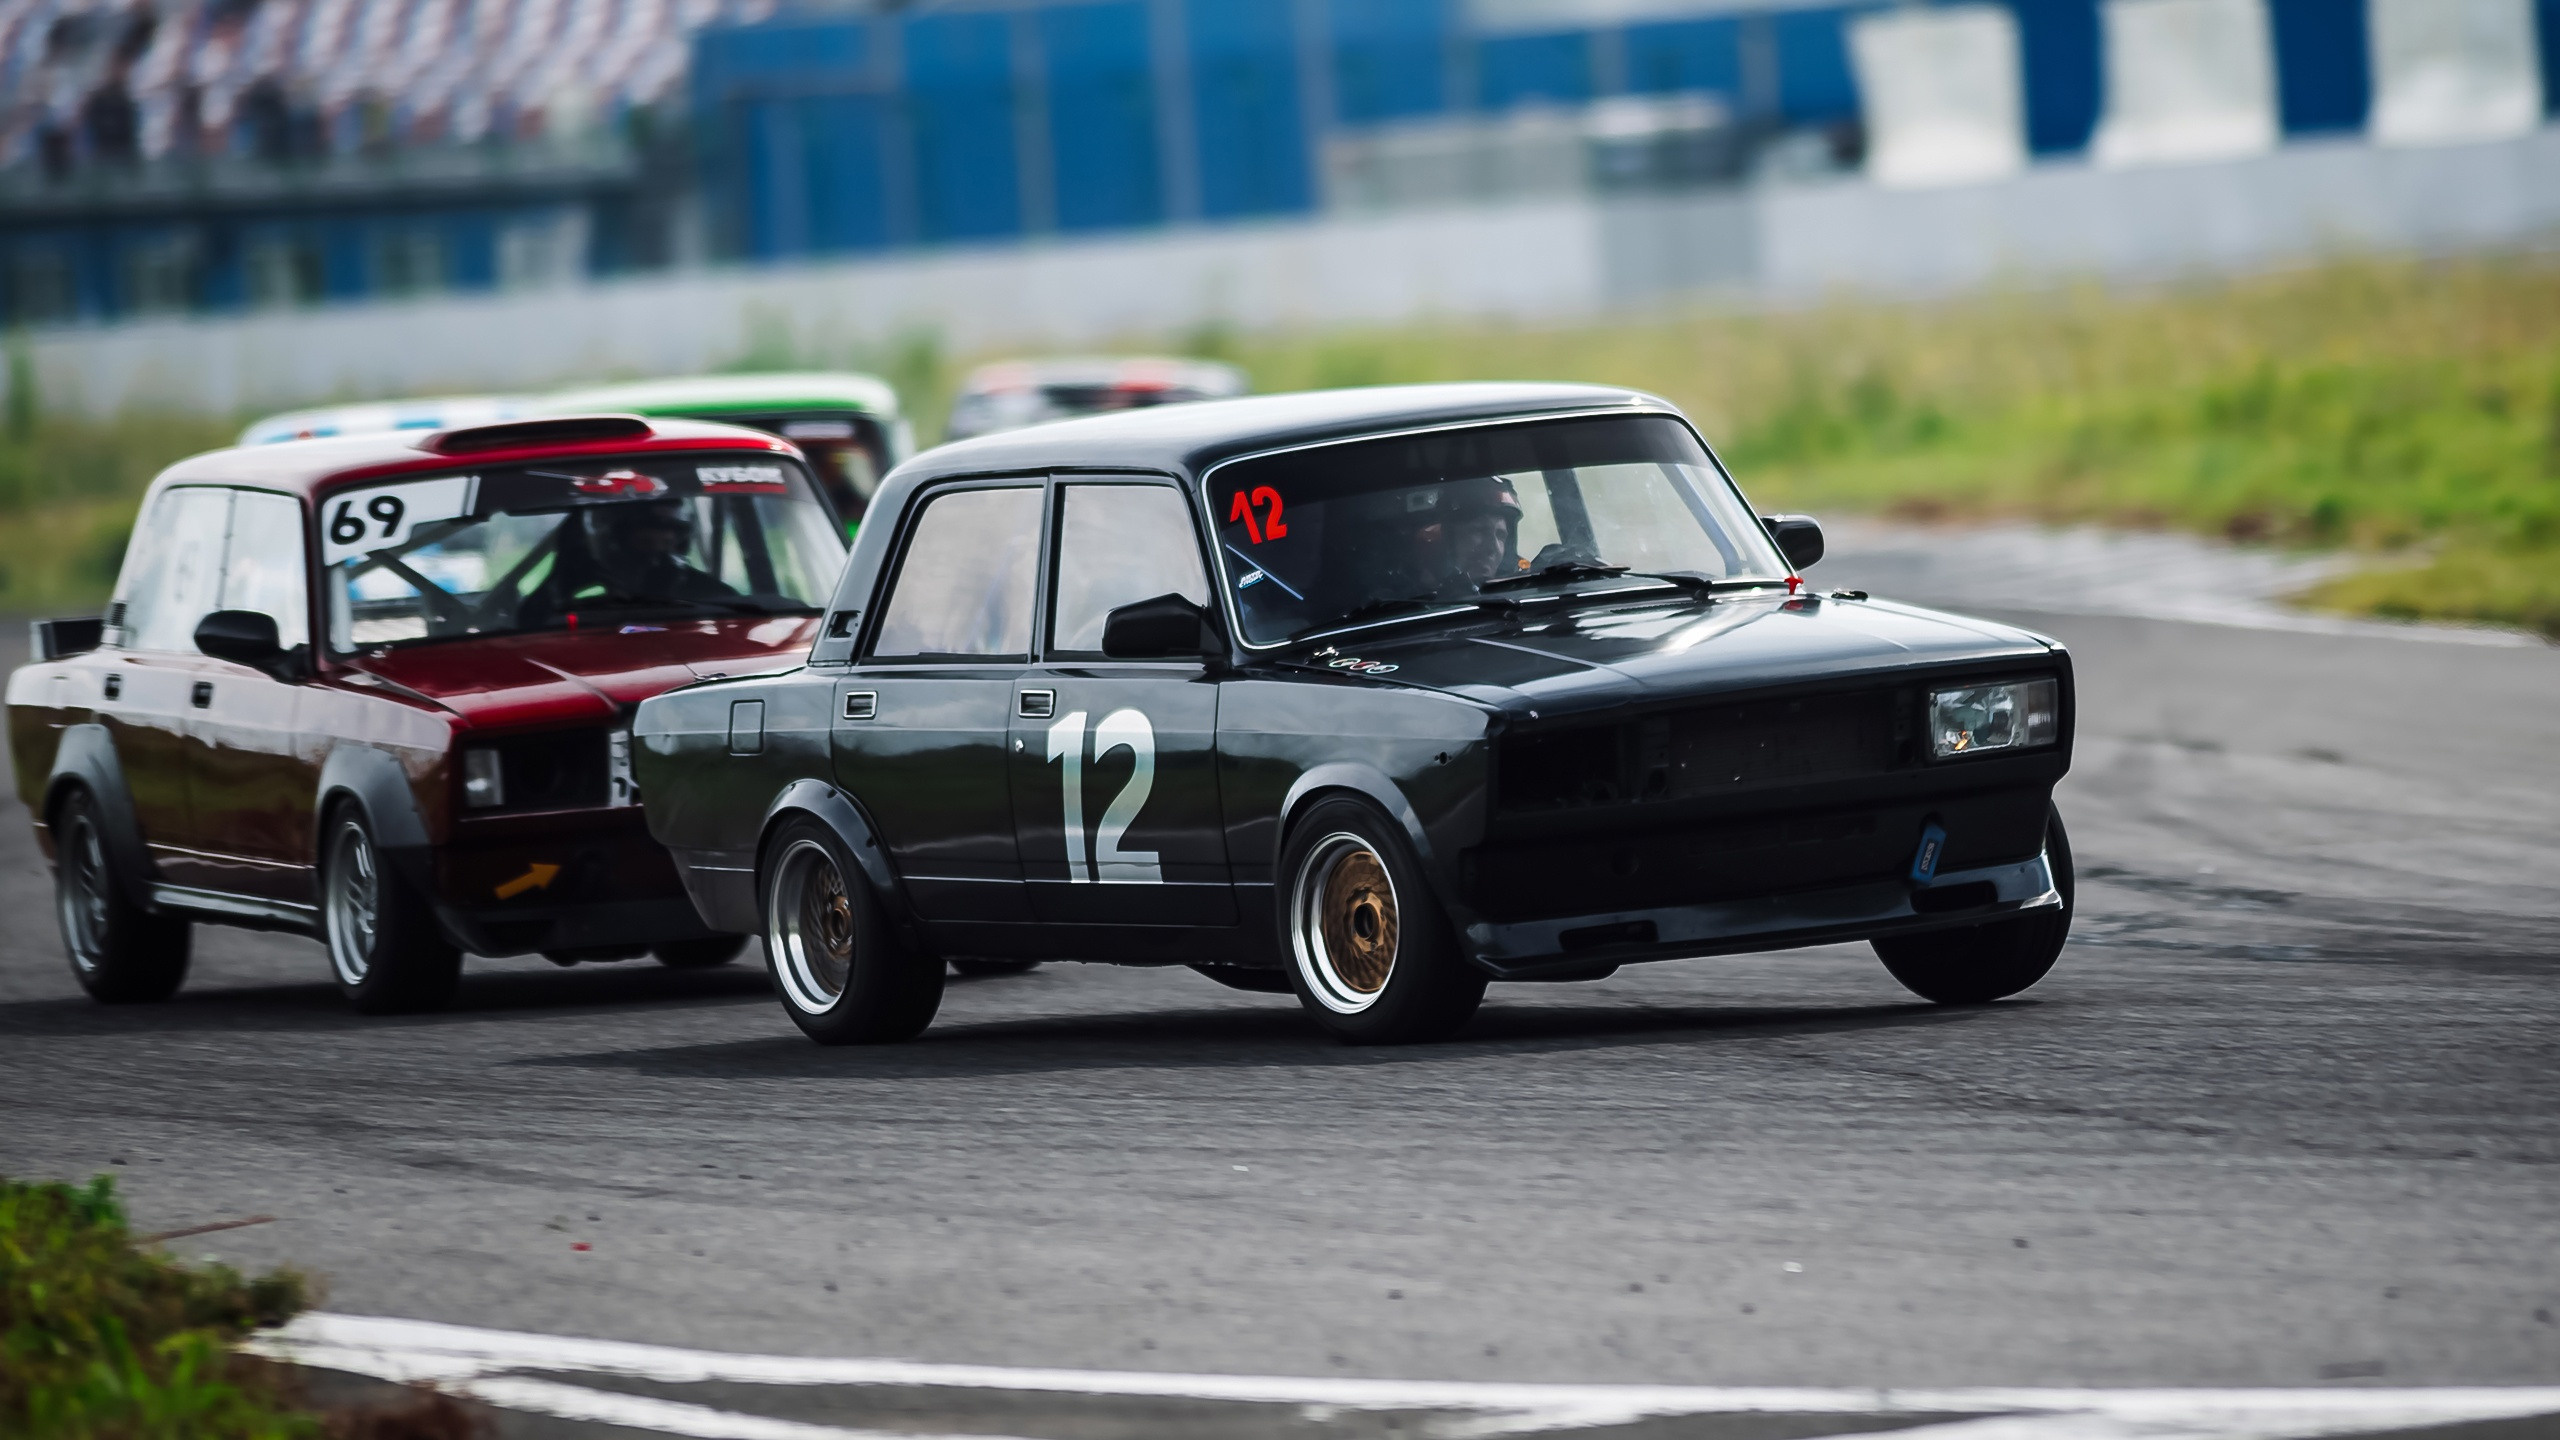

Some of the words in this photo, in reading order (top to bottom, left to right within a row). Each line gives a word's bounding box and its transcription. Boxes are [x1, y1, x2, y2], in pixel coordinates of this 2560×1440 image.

[330, 495, 404, 545] 69
[1230, 486, 1288, 544] 12
[1047, 709, 1163, 884] 12
